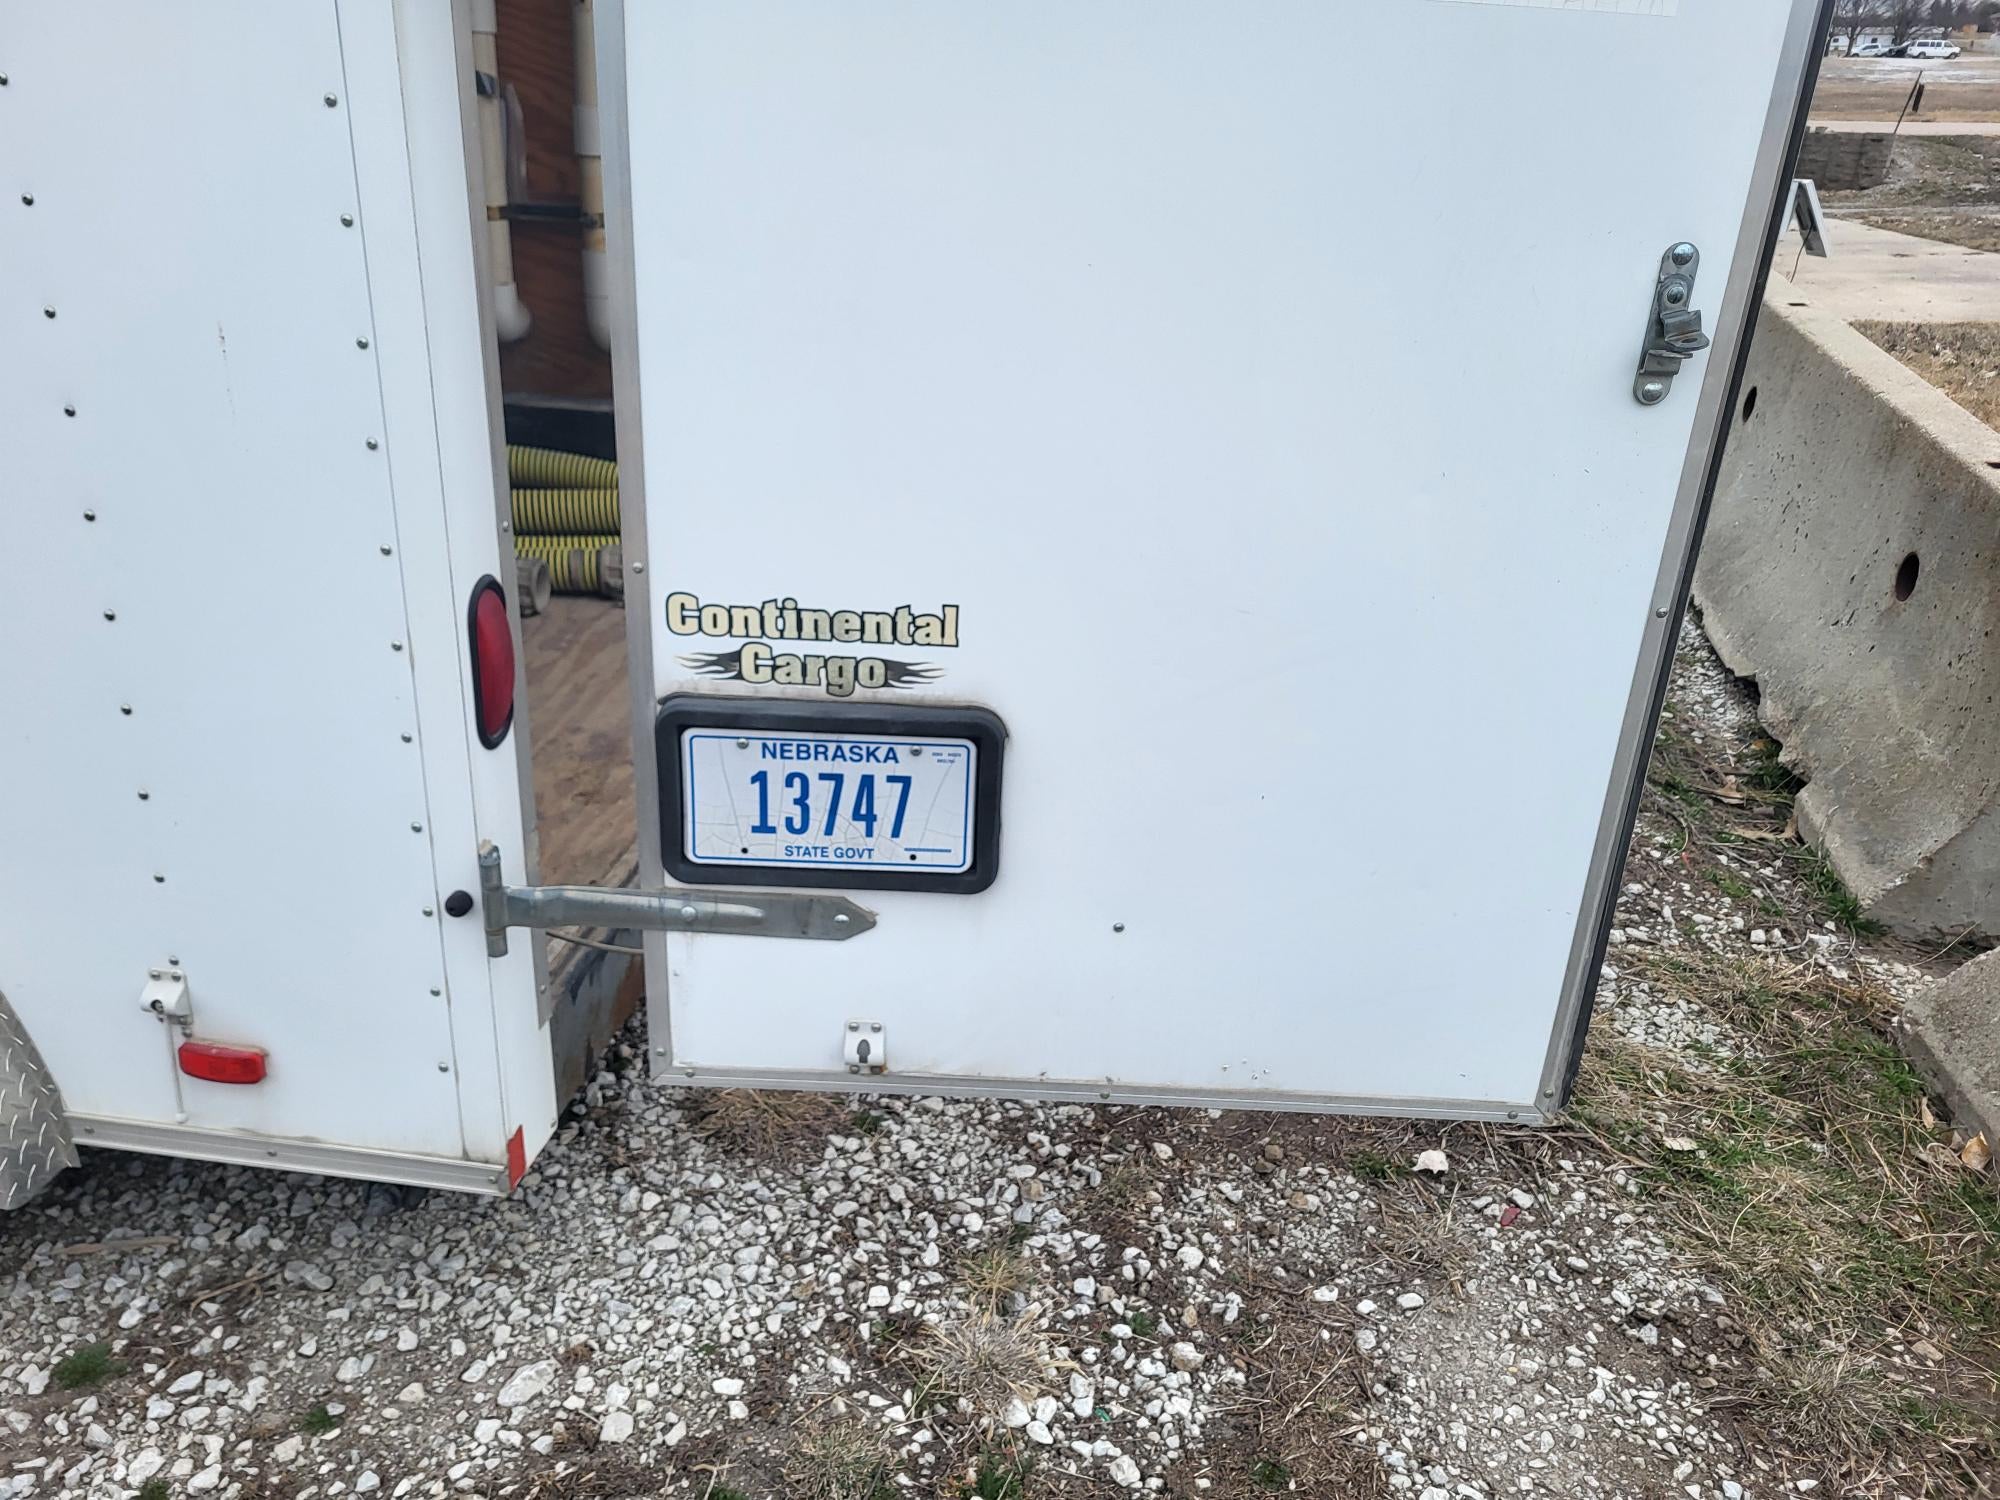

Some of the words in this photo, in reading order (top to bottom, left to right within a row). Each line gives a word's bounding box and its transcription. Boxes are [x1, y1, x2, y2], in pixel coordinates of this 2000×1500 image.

[665, 592, 960, 647] Continental
[739, 642, 889, 697] Cargo
[761, 742, 900, 764] NEBRASKA
[750, 770, 912, 839] 13747
[784, 845, 829, 858] STATE
[833, 847, 874, 860] GOVT
